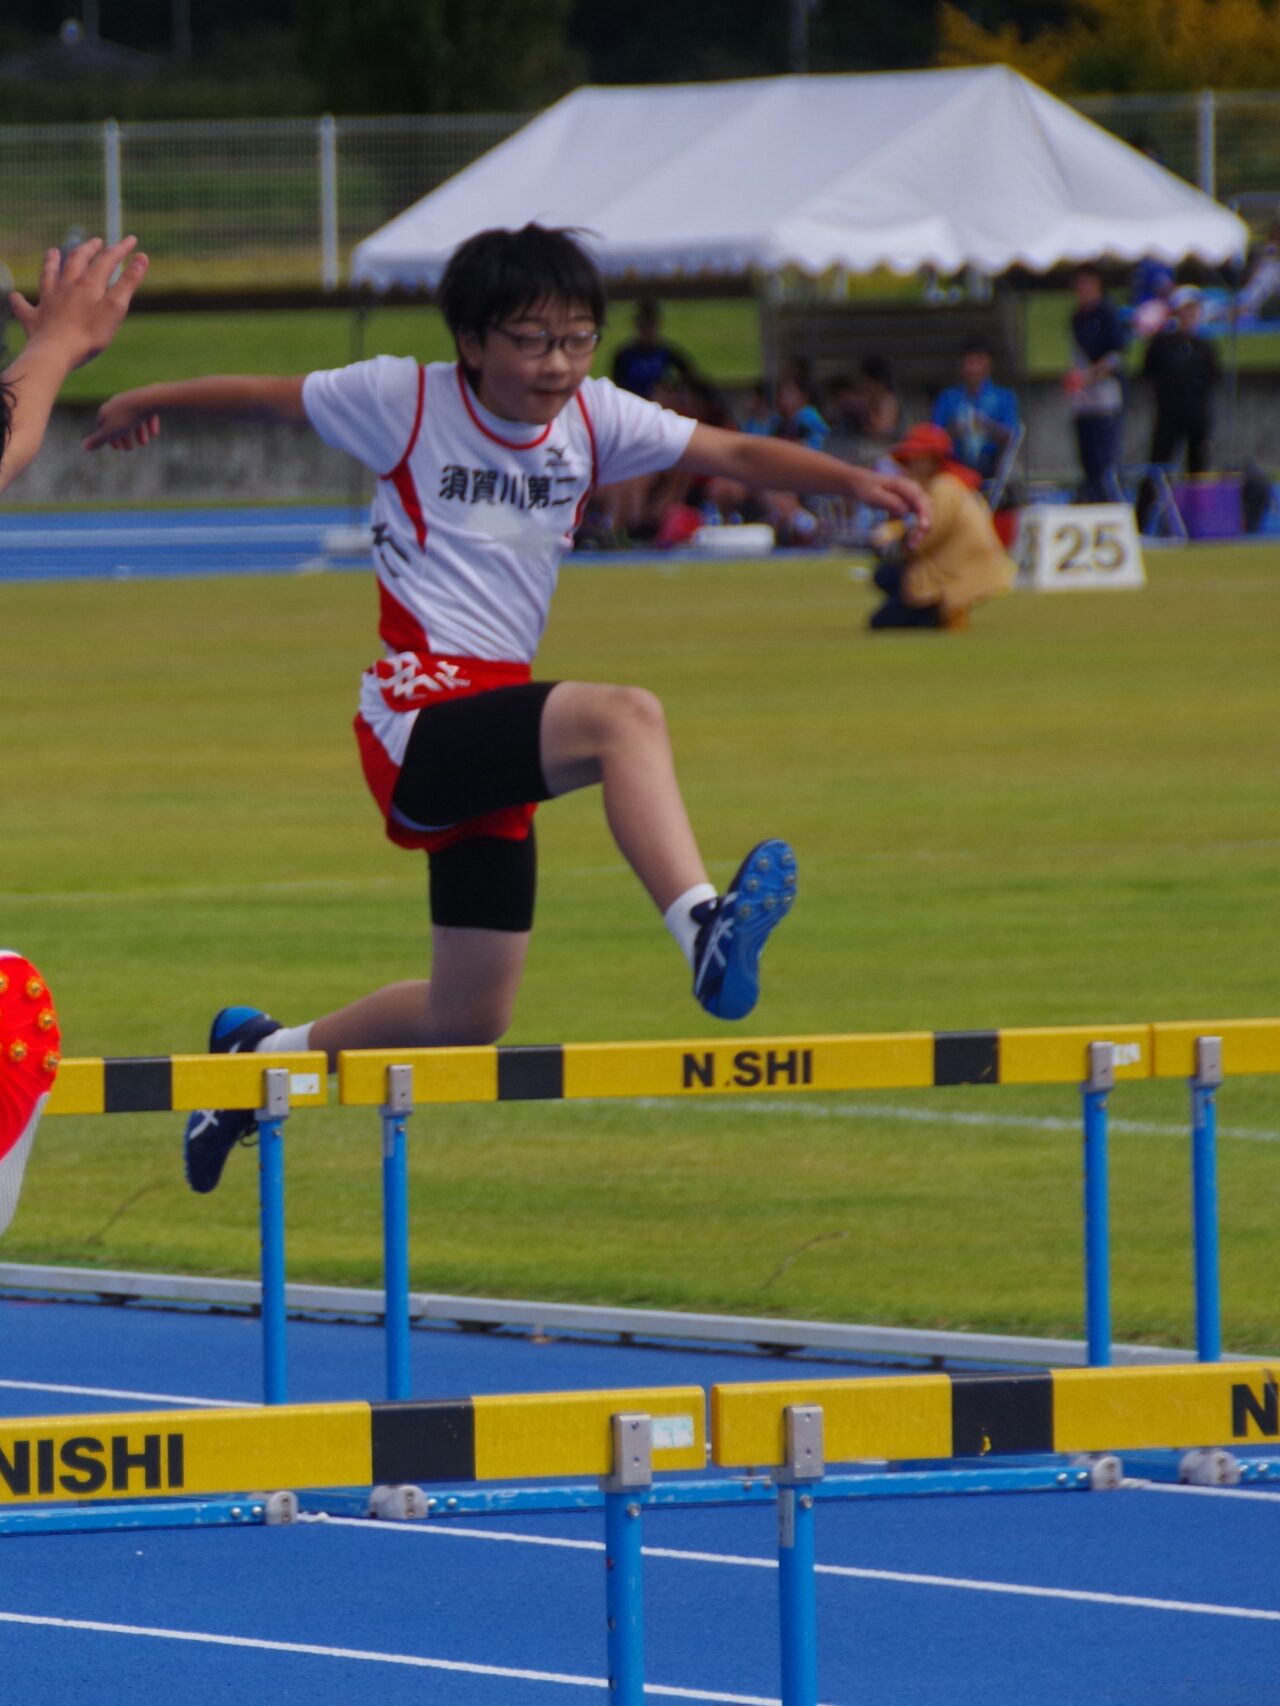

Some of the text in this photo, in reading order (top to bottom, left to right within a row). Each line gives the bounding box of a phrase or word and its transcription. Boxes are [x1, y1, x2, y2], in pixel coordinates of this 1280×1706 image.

[438, 464, 577, 509] 須賀川第二
[1052, 522, 1126, 574] 25
